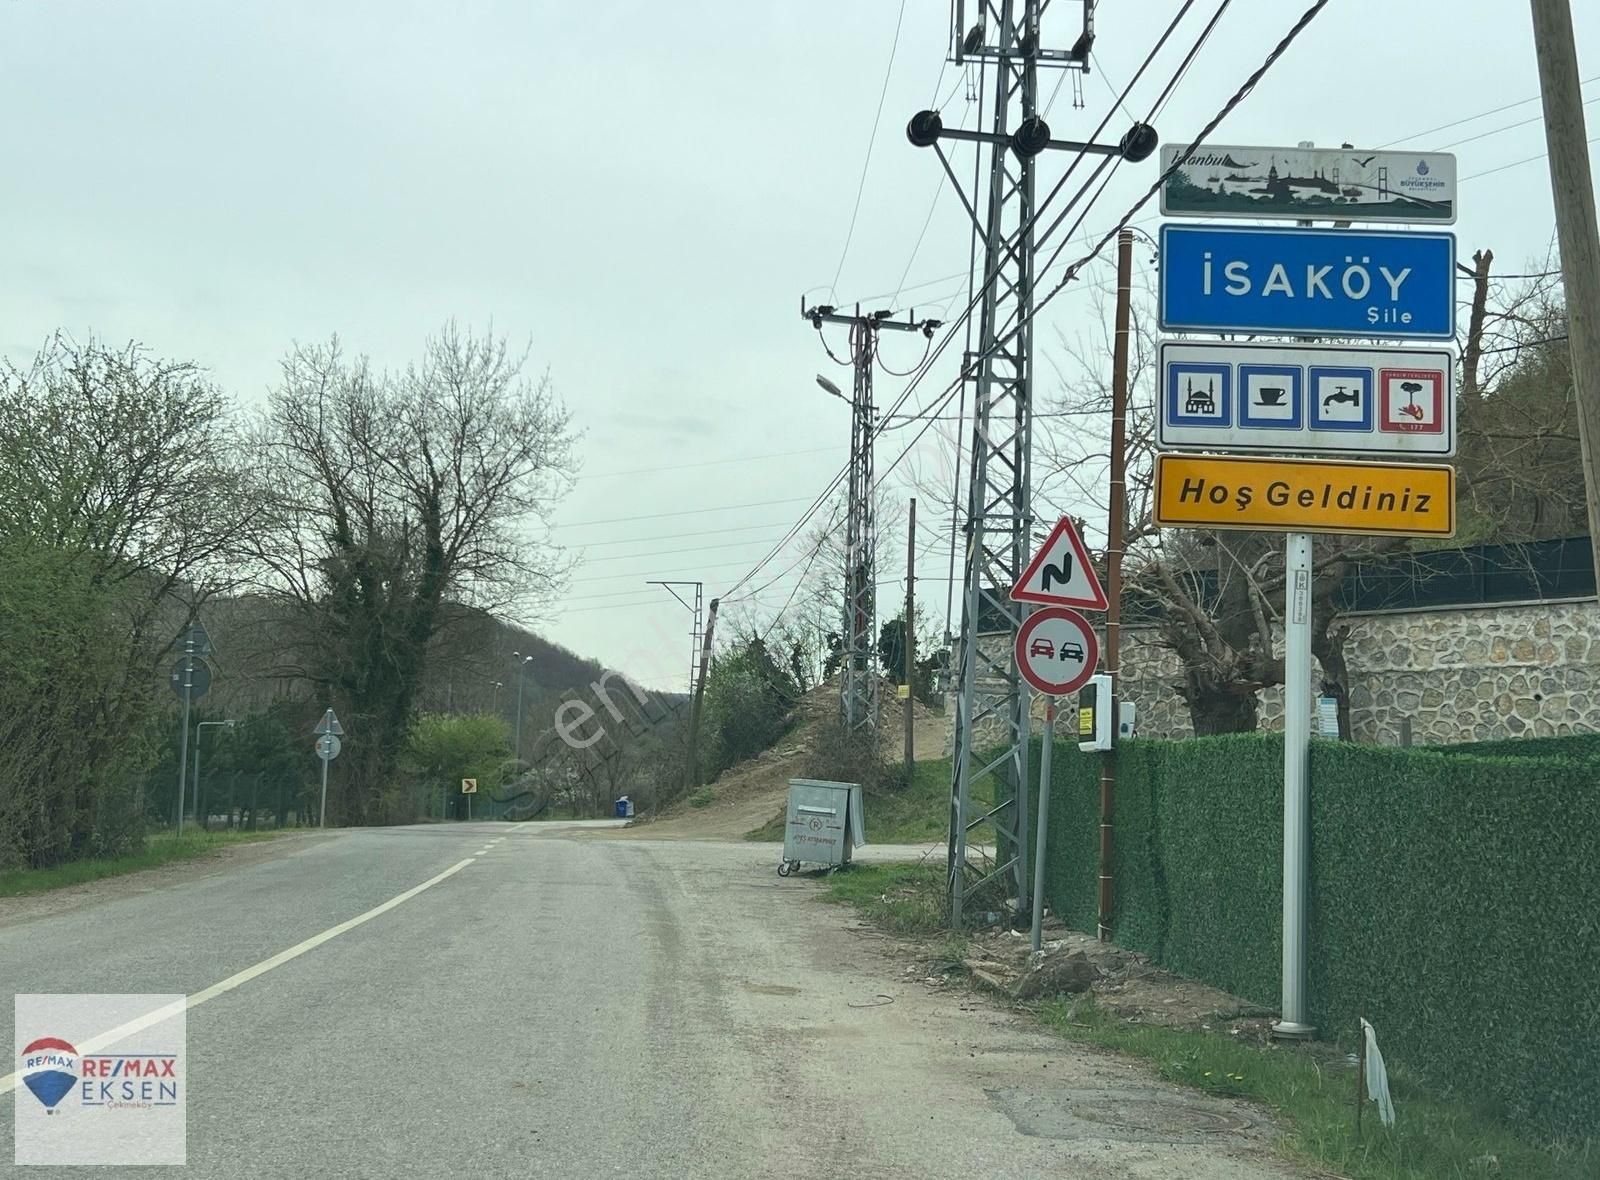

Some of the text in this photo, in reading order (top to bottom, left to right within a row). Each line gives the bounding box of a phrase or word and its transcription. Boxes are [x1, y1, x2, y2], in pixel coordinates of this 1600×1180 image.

[1171, 150, 1230, 167] İanbul
[1203, 252, 1412, 301] İSAKÖY
[1367, 306, 1412, 324] Şile
[1179, 478, 1432, 514] Hoş Geldiniz
